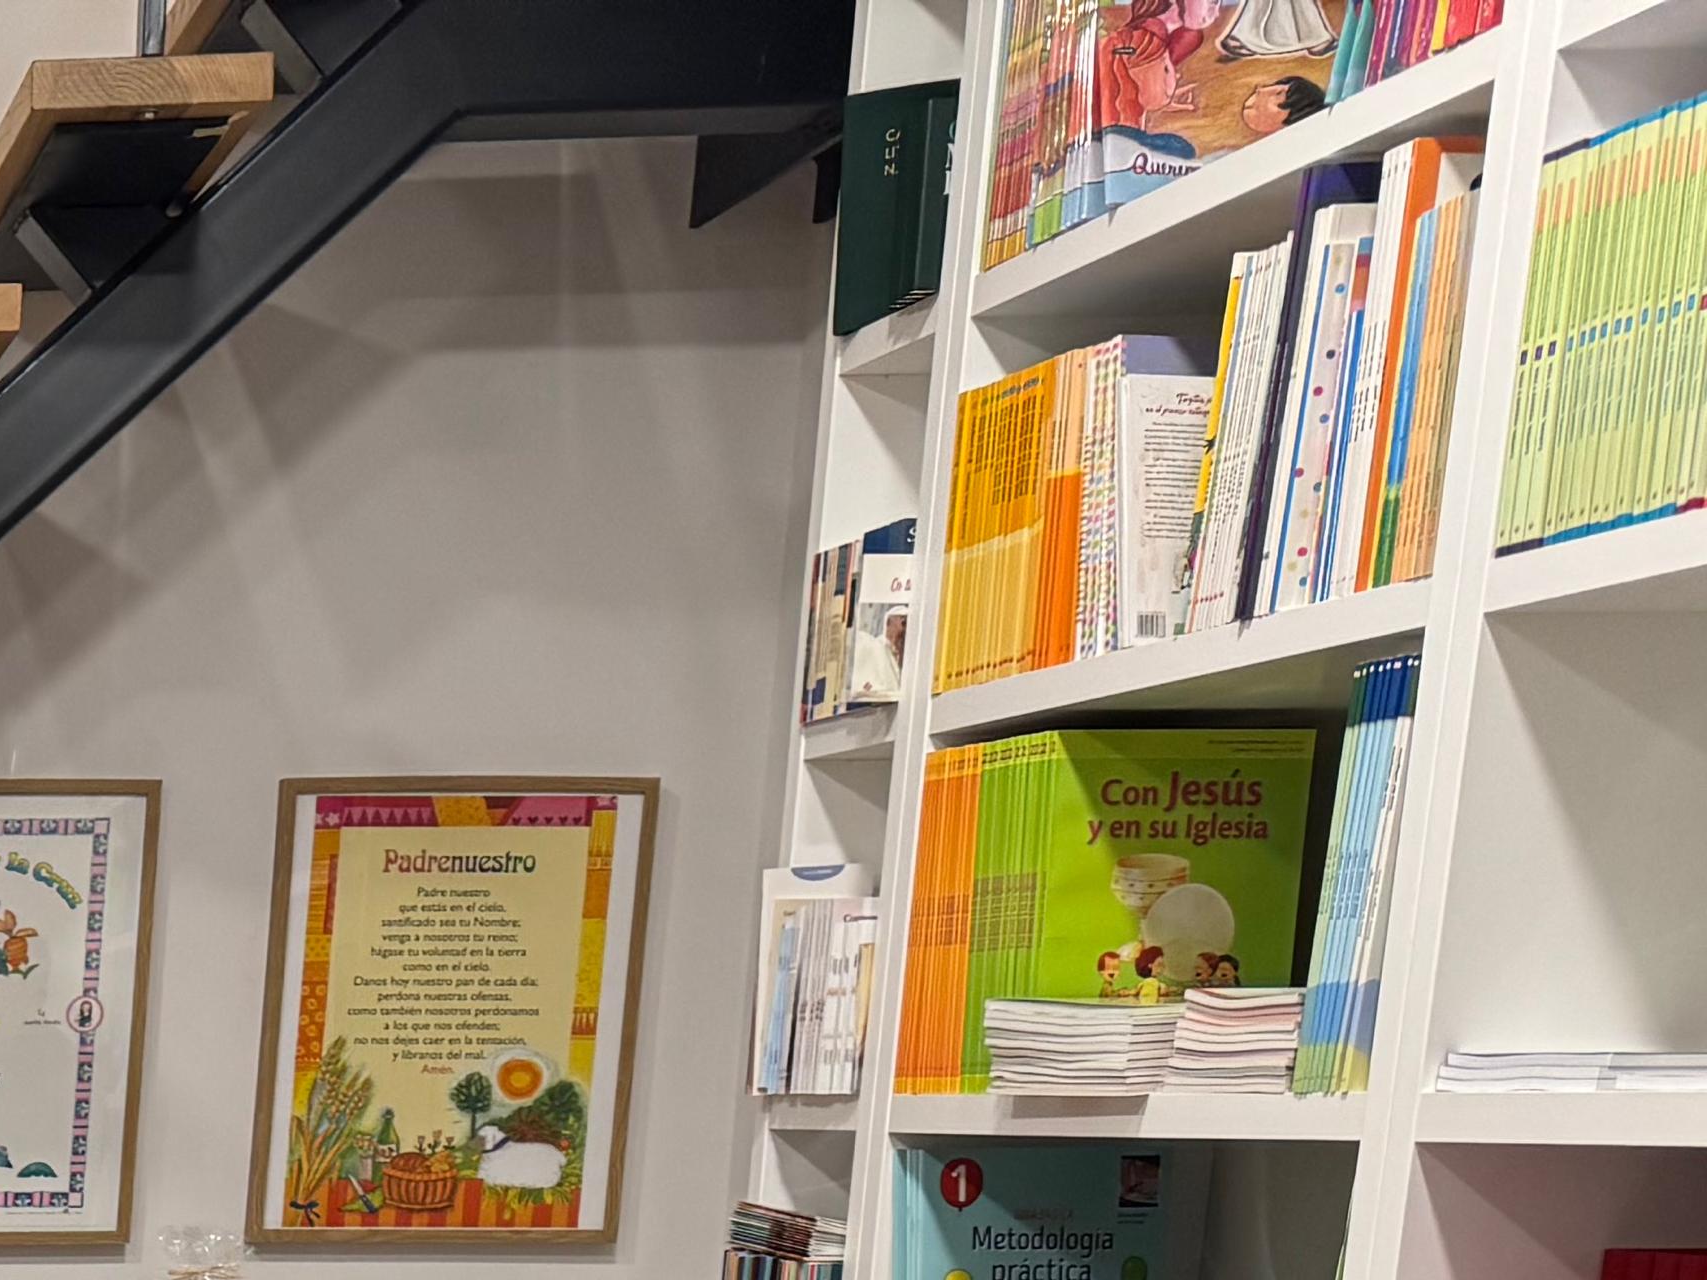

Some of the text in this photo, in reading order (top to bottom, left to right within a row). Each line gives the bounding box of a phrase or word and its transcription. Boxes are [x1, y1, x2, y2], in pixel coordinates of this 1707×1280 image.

[1101, 769, 1262, 812] Con Jesús
[1087, 812, 1268, 847] y en su Iglesia
[382, 849, 536, 873] Padrenuestro
[417, 887, 490, 897] Padre nuestro
[951, 1164, 967, 1202] 1
